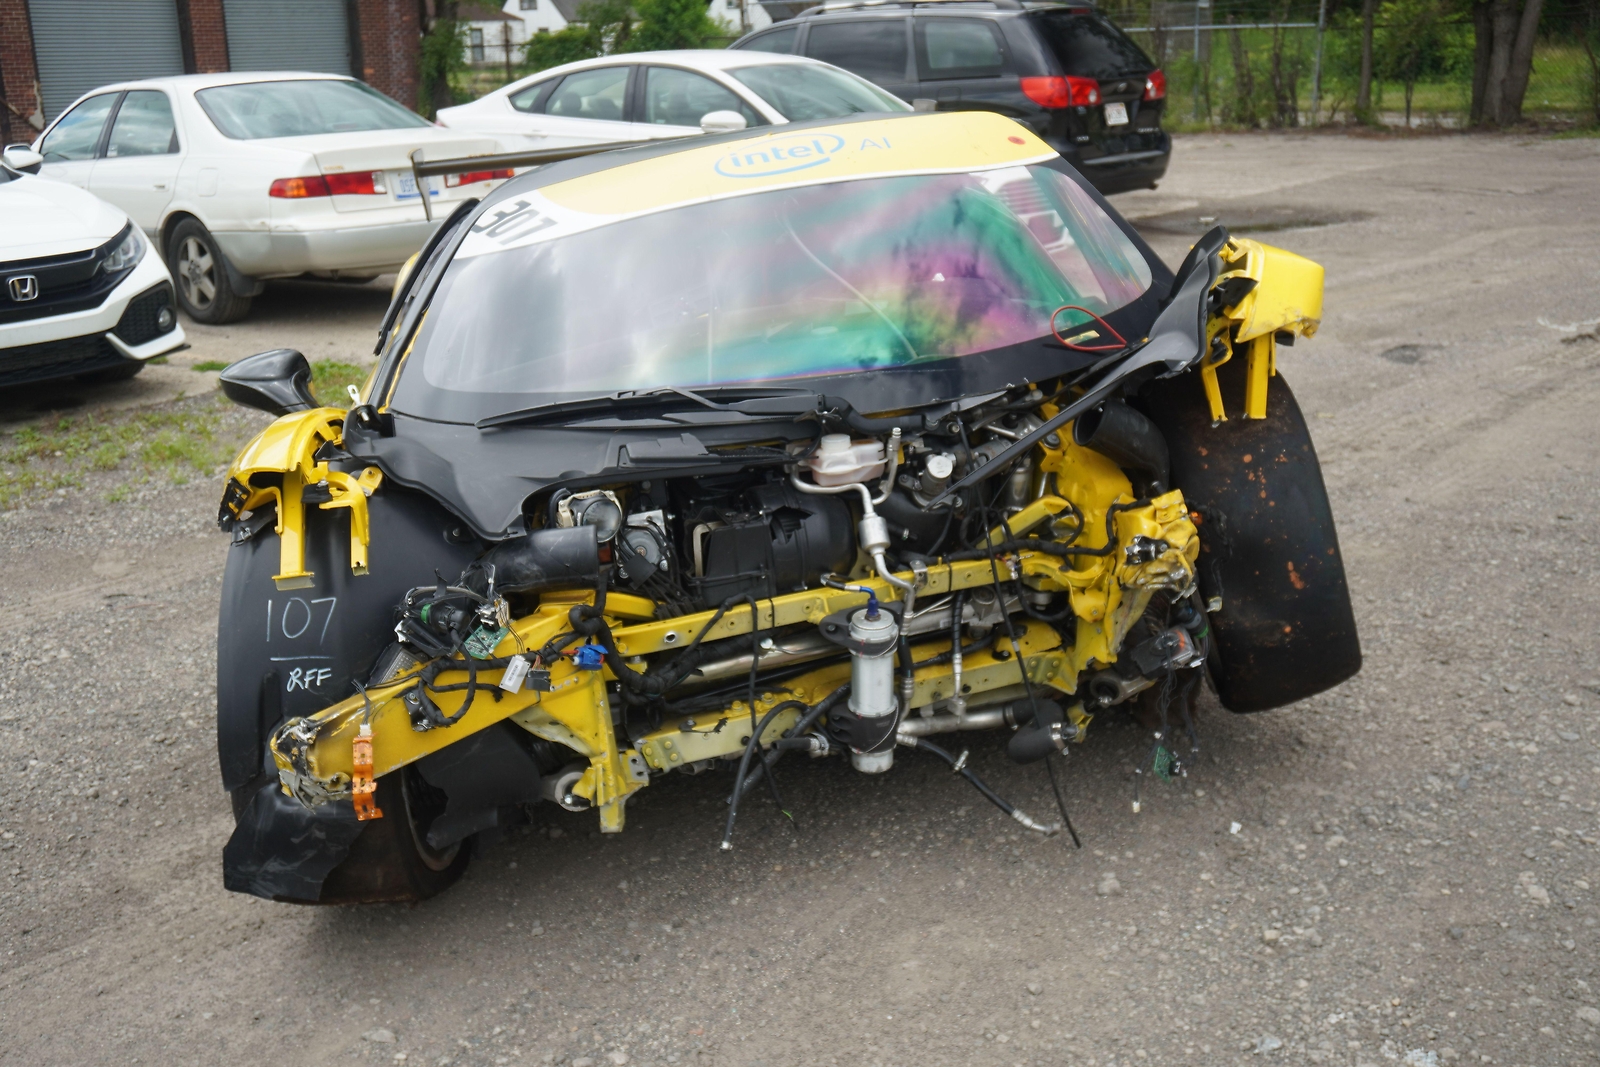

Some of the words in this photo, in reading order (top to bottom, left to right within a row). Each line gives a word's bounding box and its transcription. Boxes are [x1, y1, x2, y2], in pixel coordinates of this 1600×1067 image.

[729, 139, 826, 168] intel
[859, 136, 892, 151] AI
[470, 199, 558, 246] 307
[266, 597, 337, 646] 107
[286, 667, 332, 692] RFF
